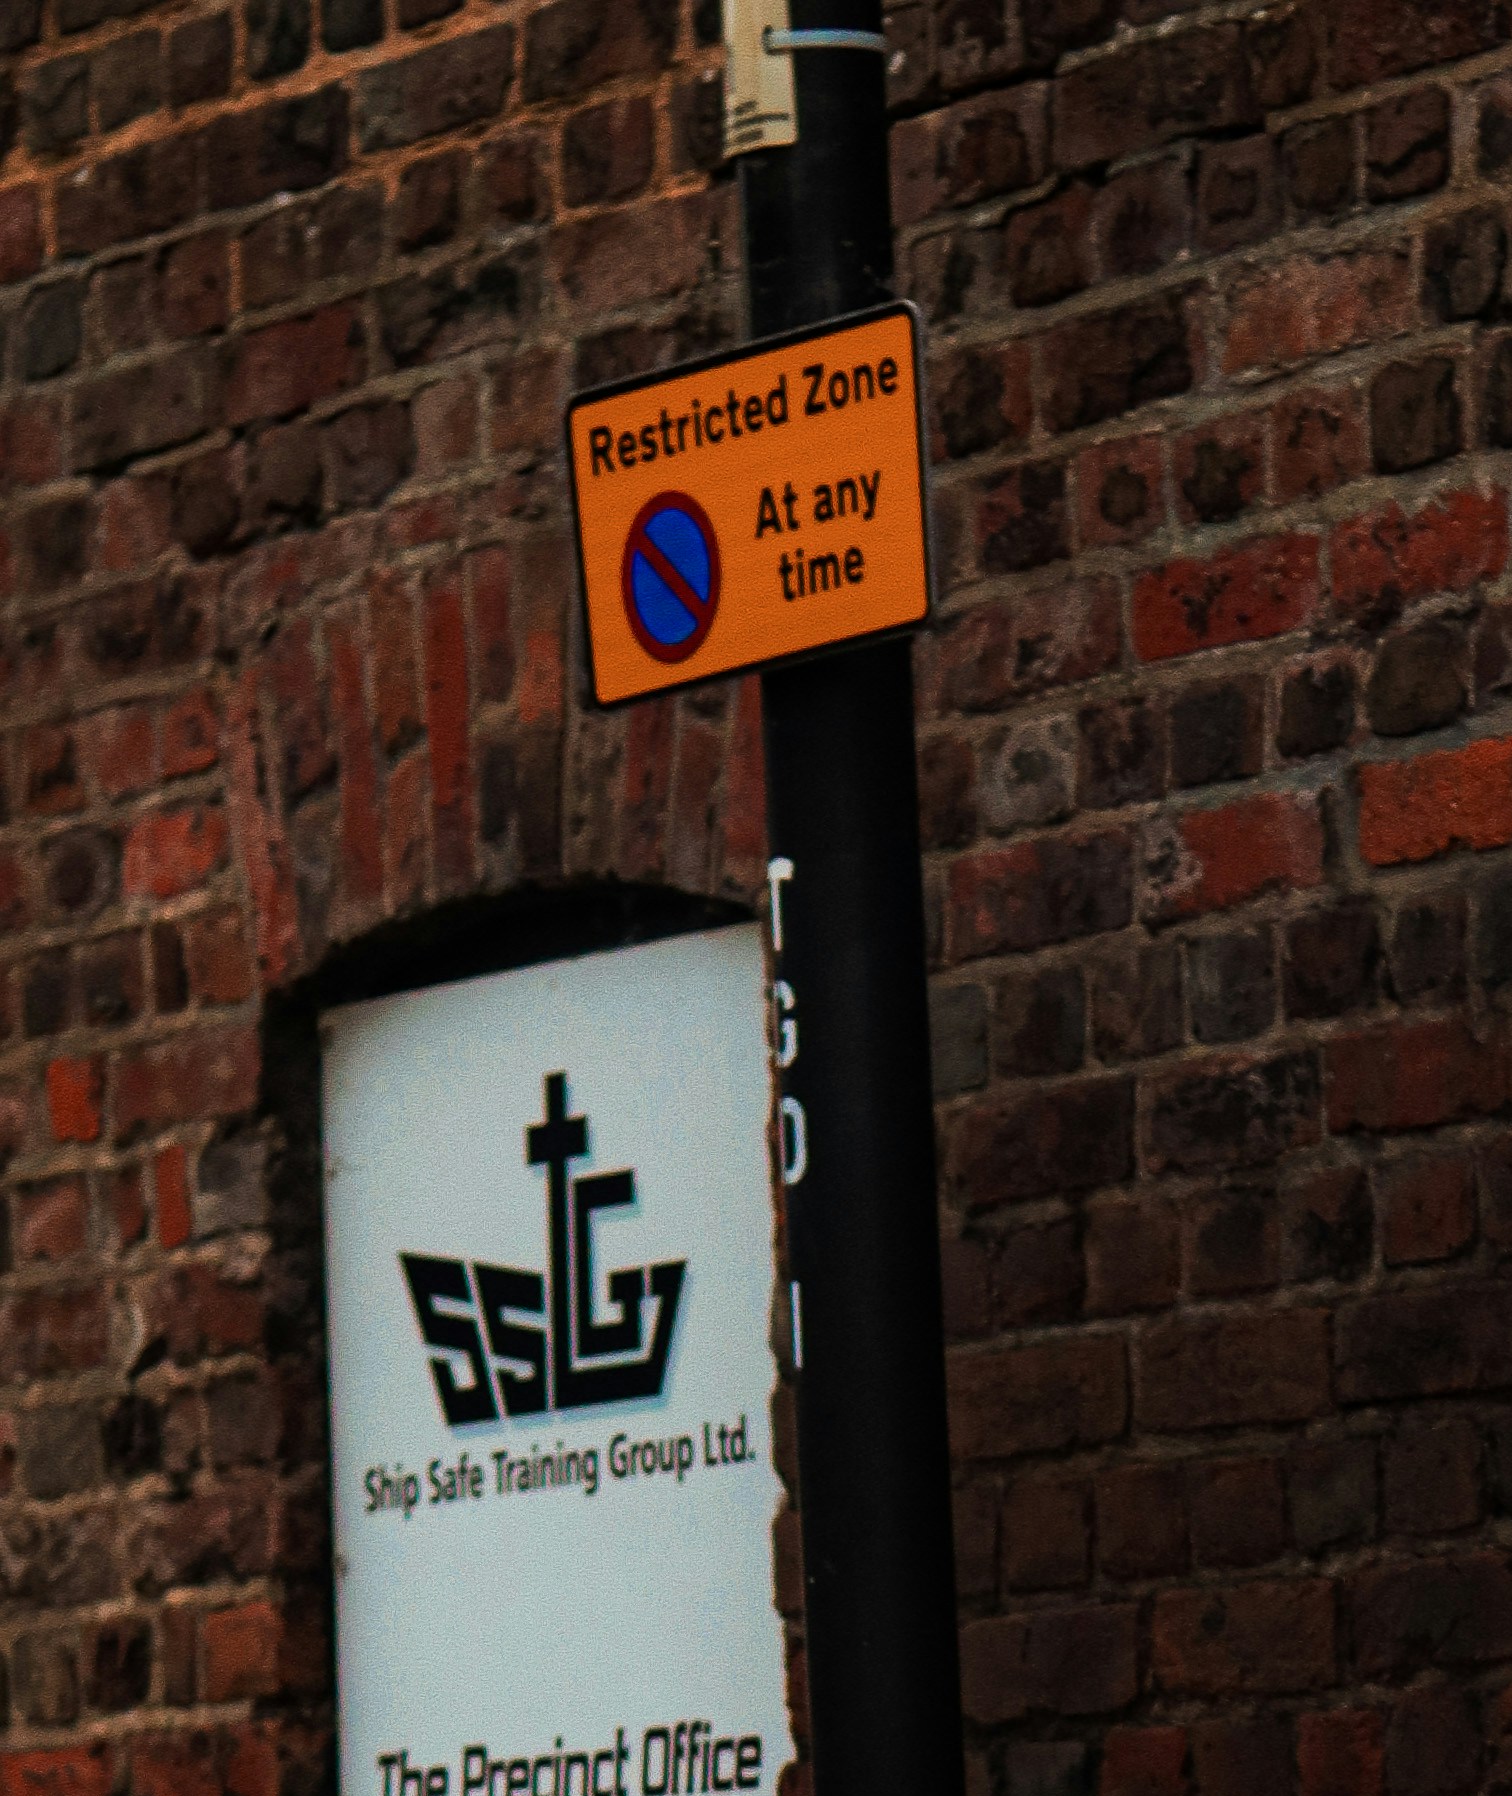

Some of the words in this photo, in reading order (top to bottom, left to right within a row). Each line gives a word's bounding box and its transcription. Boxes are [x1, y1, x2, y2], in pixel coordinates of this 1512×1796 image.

[589, 372, 788, 477] Restricted
[803, 356, 898, 416] Zone
[754, 482, 799, 538] At
[813, 469, 881, 521] any
[779, 546, 865, 601] time
[363, 1463, 419, 1519] Ship
[428, 1451, 484, 1504] Safe
[491, 1440, 599, 1496] Training
[608, 1430, 694, 1485] Group
[703, 1412, 757, 1467] Ltd.
[641, 1719, 763, 1796] Office
